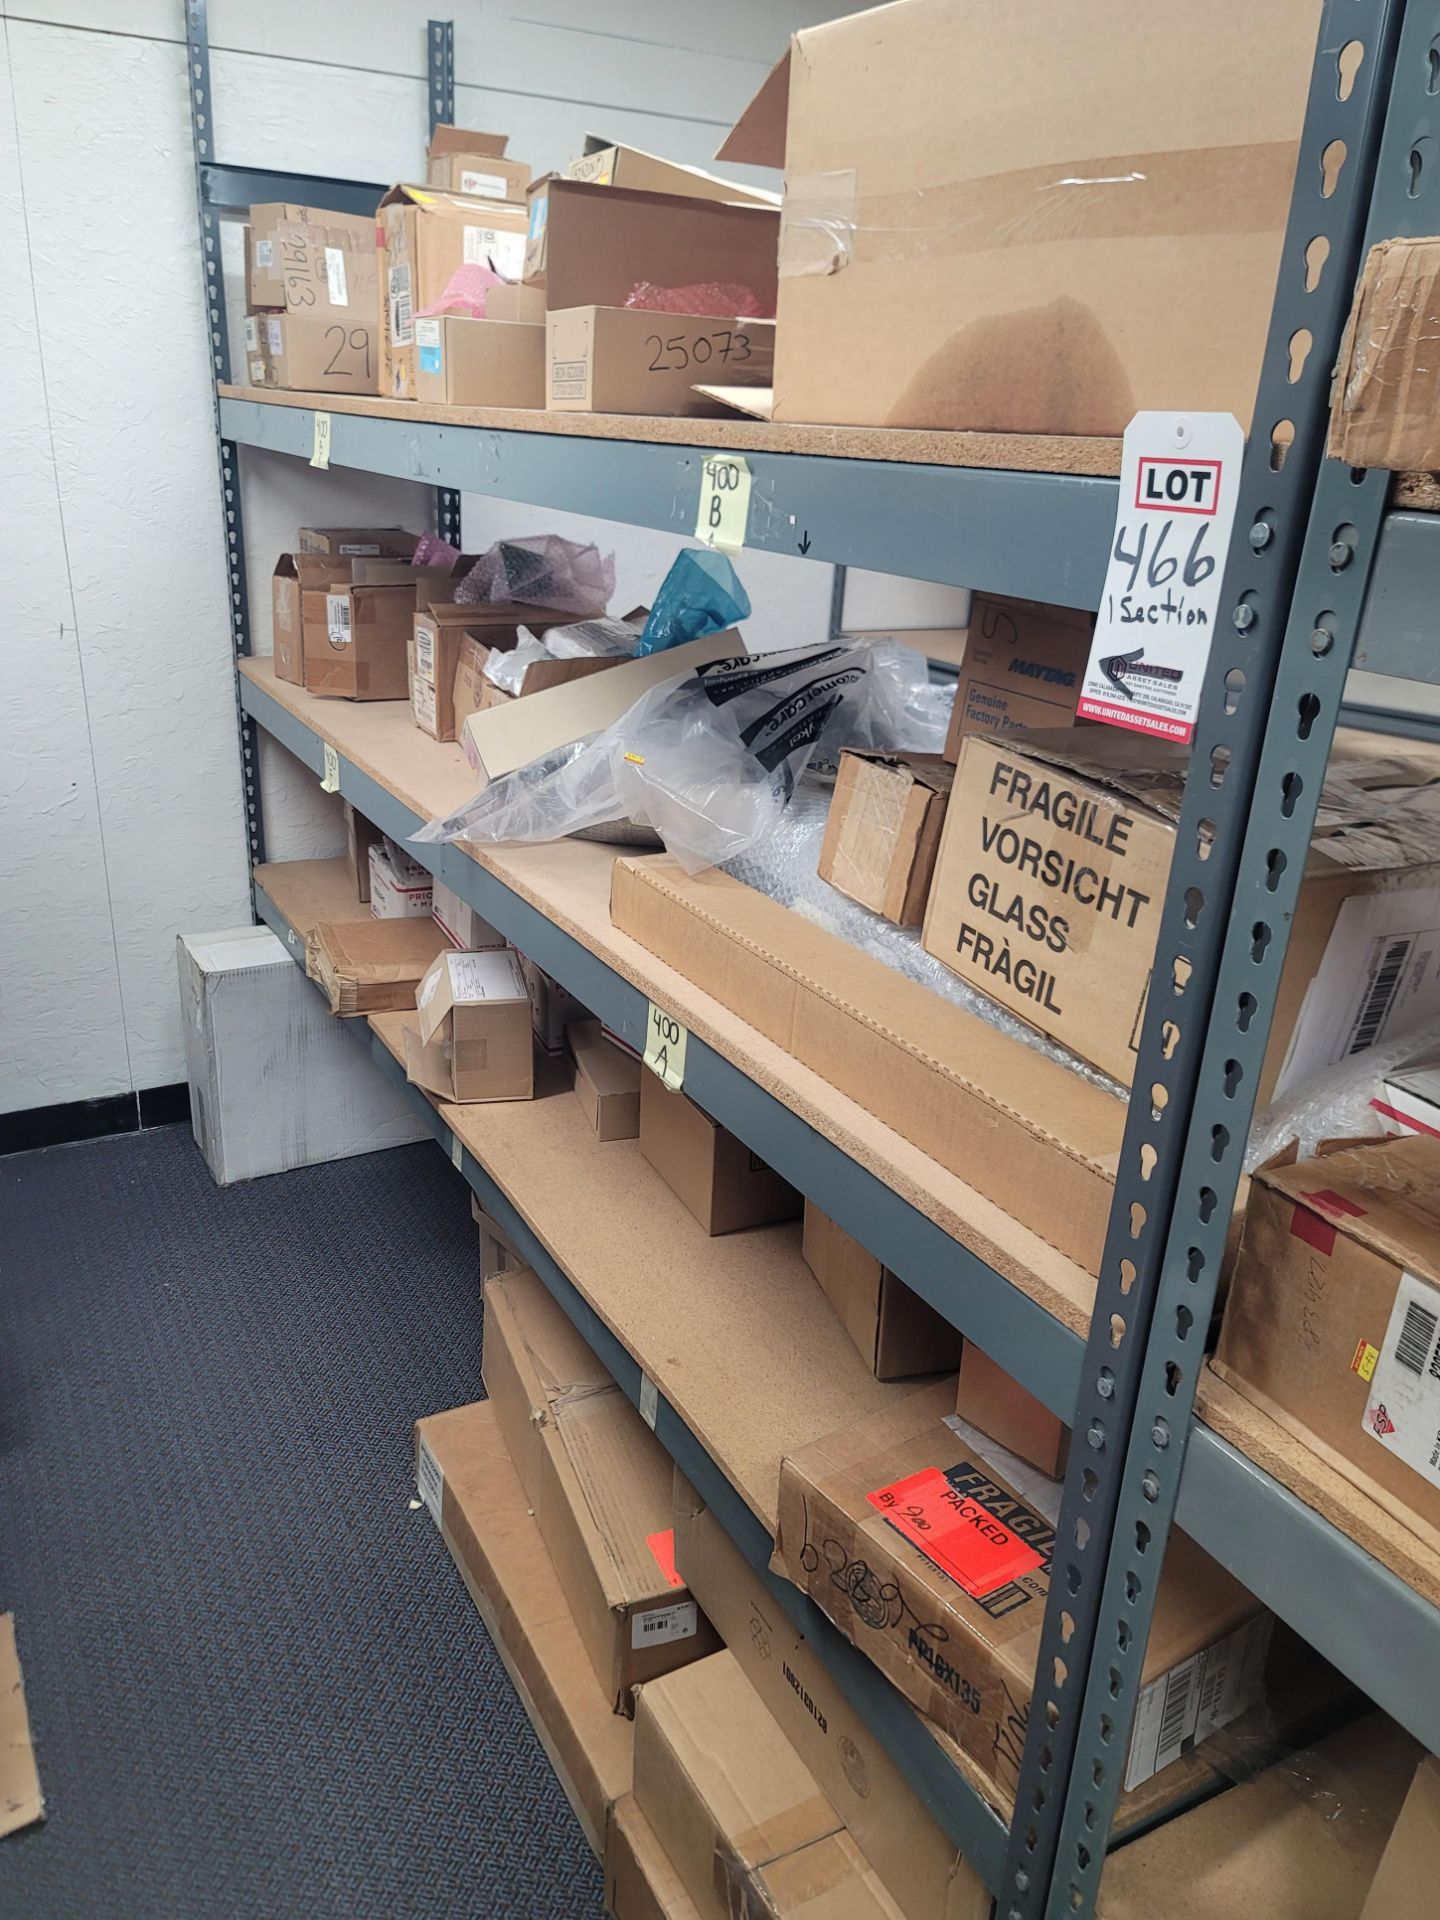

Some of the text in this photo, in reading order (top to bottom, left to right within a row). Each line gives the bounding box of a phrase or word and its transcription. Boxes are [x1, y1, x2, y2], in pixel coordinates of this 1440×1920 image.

[323, 325, 370, 378] 29
[645, 332, 751, 371] 25073
[706, 462, 740, 491] 400
[1146, 468, 1211, 502] LOT
[709, 495, 722, 528] B
[1113, 520, 1215, 592] 466
[1120, 588, 1208, 624] Section
[1007, 659, 1077, 688] MAYTAG
[1129, 660, 1181, 679] UNITED
[966, 706, 1000, 729] Factory
[968, 689, 1008, 711] Genuine
[1082, 702, 1187, 737] WWW.UNITEDASSETSALES.COM
[989, 761, 1134, 857] FRAGILE
[982, 817, 1150, 928] VORSICHT
[967, 873, 1070, 953] GLASS
[956, 922, 1062, 1015] FRÀGIL
[653, 1008, 680, 1045] 400
[654, 1045, 668, 1077] A
[1373, 1403, 1388, 1438] FSP
[879, 1492, 899, 1508] By
[954, 1472, 1055, 1556] FRAGIL
[940, 1490, 1009, 1546] PACKED
